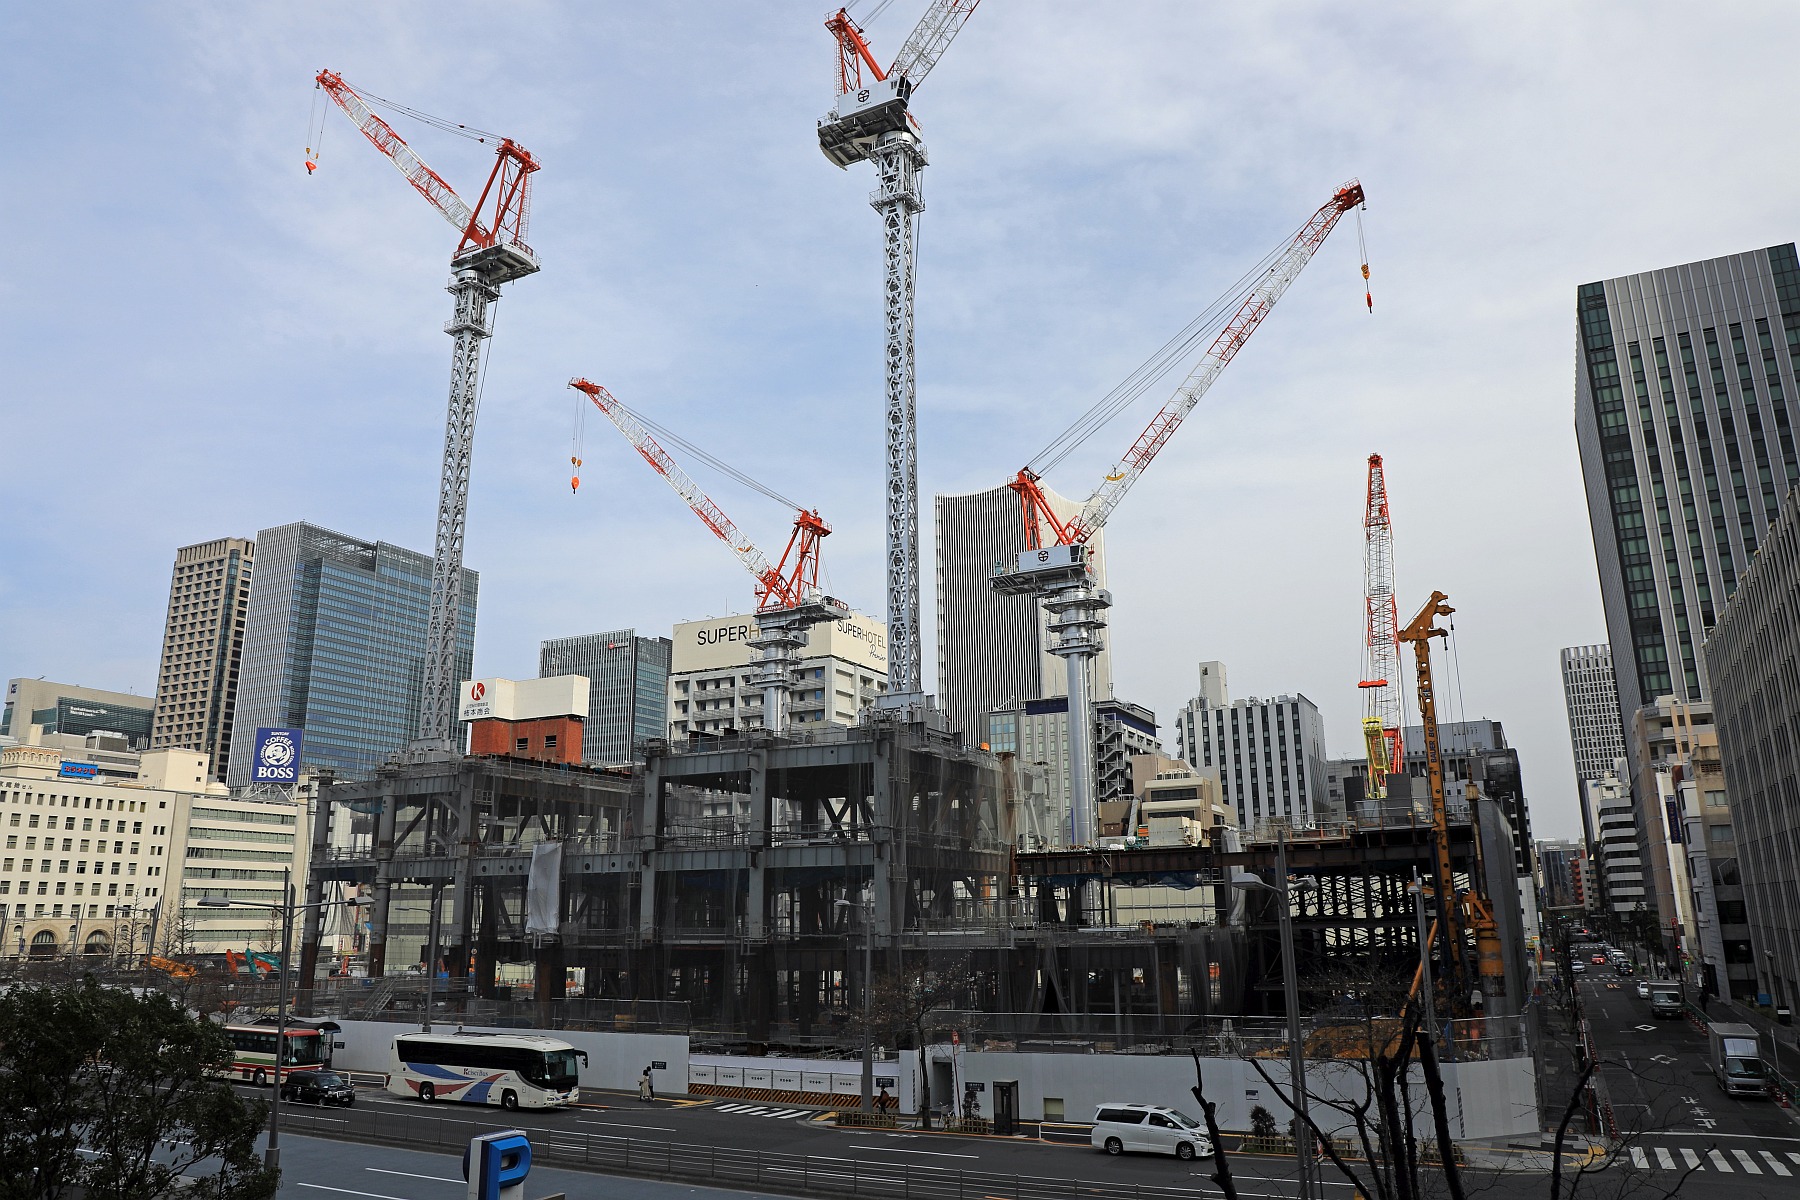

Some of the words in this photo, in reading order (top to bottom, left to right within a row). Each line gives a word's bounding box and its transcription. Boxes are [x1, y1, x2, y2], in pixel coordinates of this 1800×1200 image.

[697, 624, 760, 646] SUPERH
[837, 621, 886, 649] SUPERHOTEL
[265, 736, 293, 746] COFFEE
[1429, 740, 1437, 763] BAUER
[257, 767, 294, 778] BOSS
